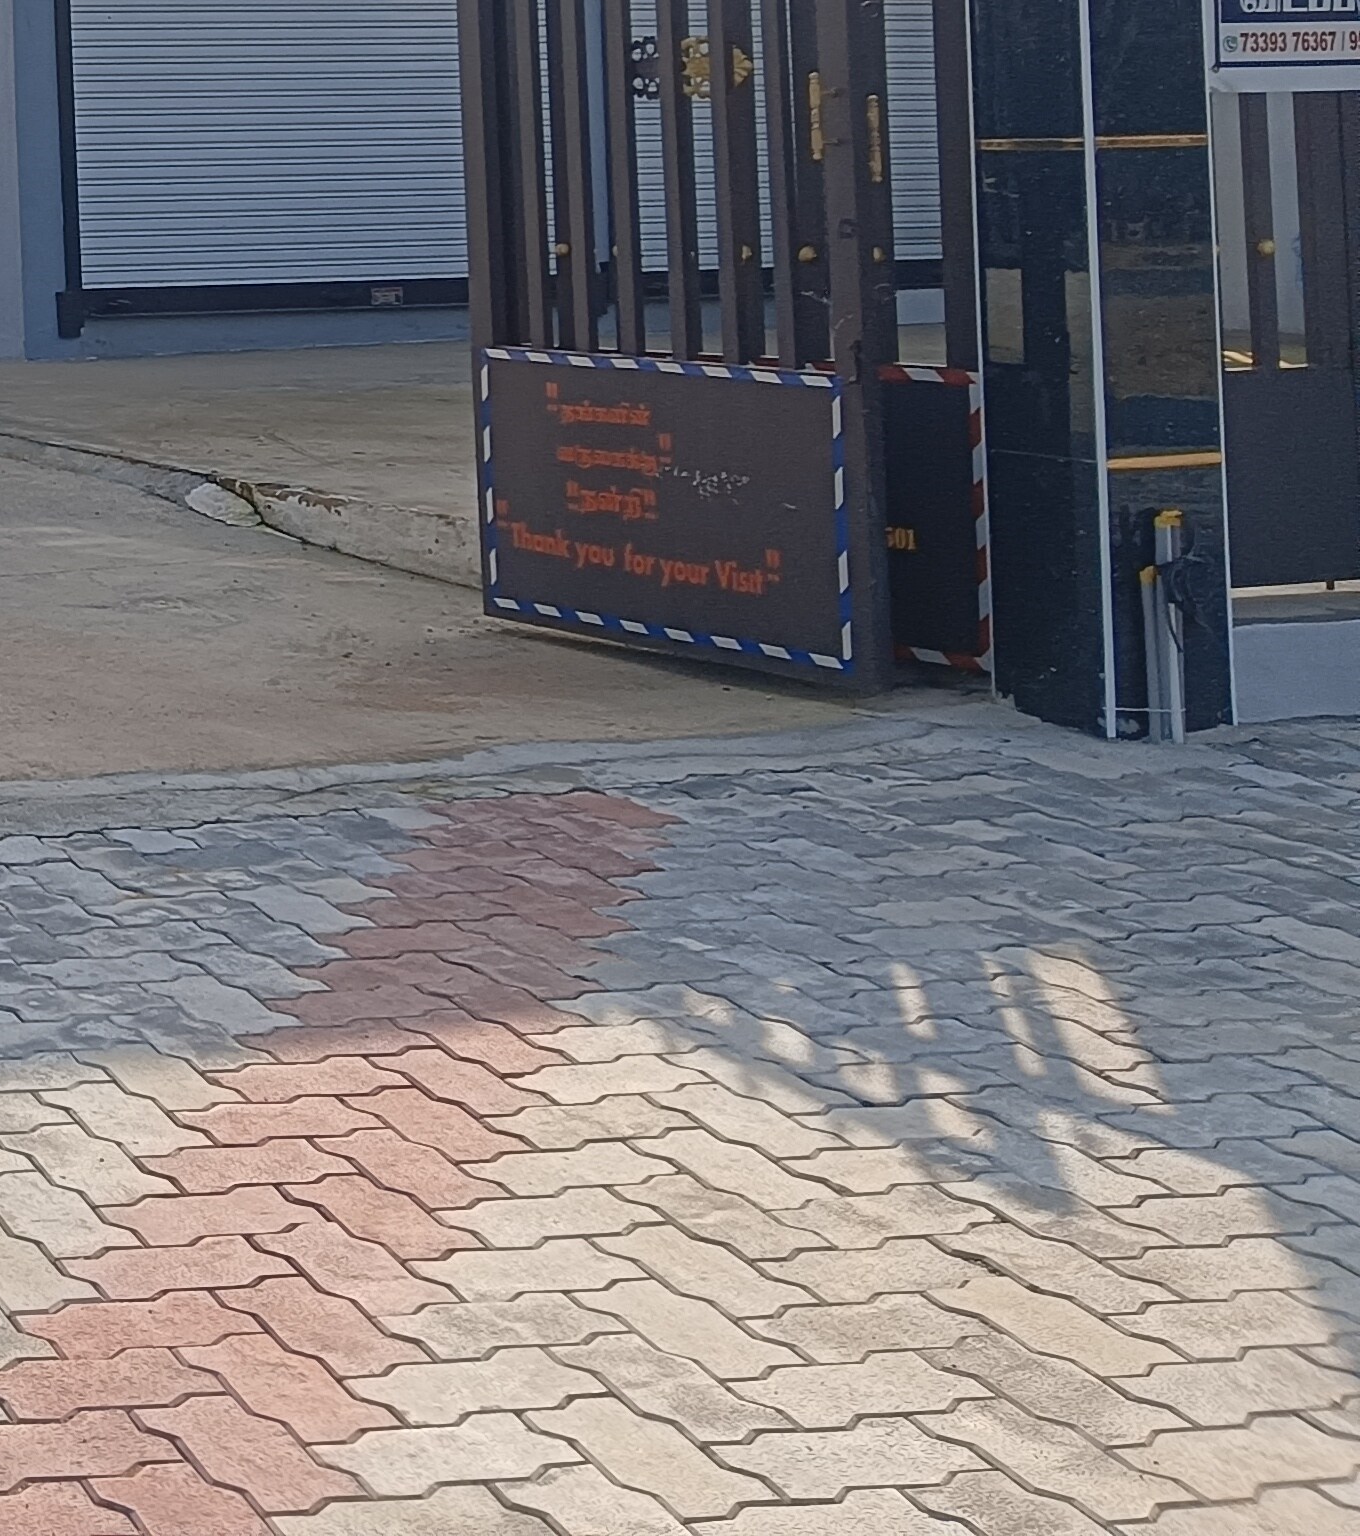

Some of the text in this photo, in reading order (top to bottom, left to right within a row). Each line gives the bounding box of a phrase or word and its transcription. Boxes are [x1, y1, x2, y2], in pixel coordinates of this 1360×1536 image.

[1239, 32, 1288, 53] 73393
[1292, 30, 1337, 52] 76367
[574, 542, 614, 569] you
[623, 543, 655, 576] for
[659, 558, 710, 588] your
